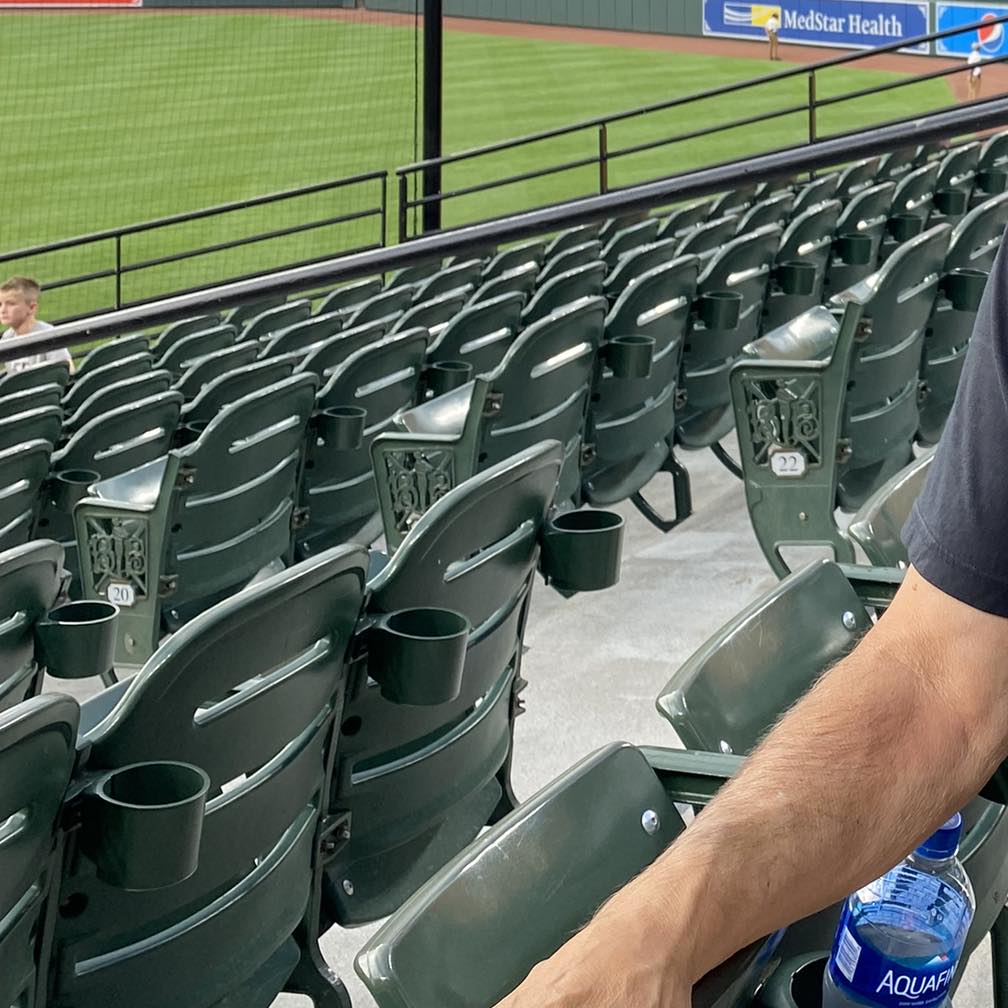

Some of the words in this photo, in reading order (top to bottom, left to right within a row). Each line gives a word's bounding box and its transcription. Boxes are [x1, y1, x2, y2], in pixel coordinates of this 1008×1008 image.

[784, 10, 846, 33] MedStar
[848, 13, 903, 38] Health
[779, 455, 798, 472] 22
[112, 586, 129, 602] 20
